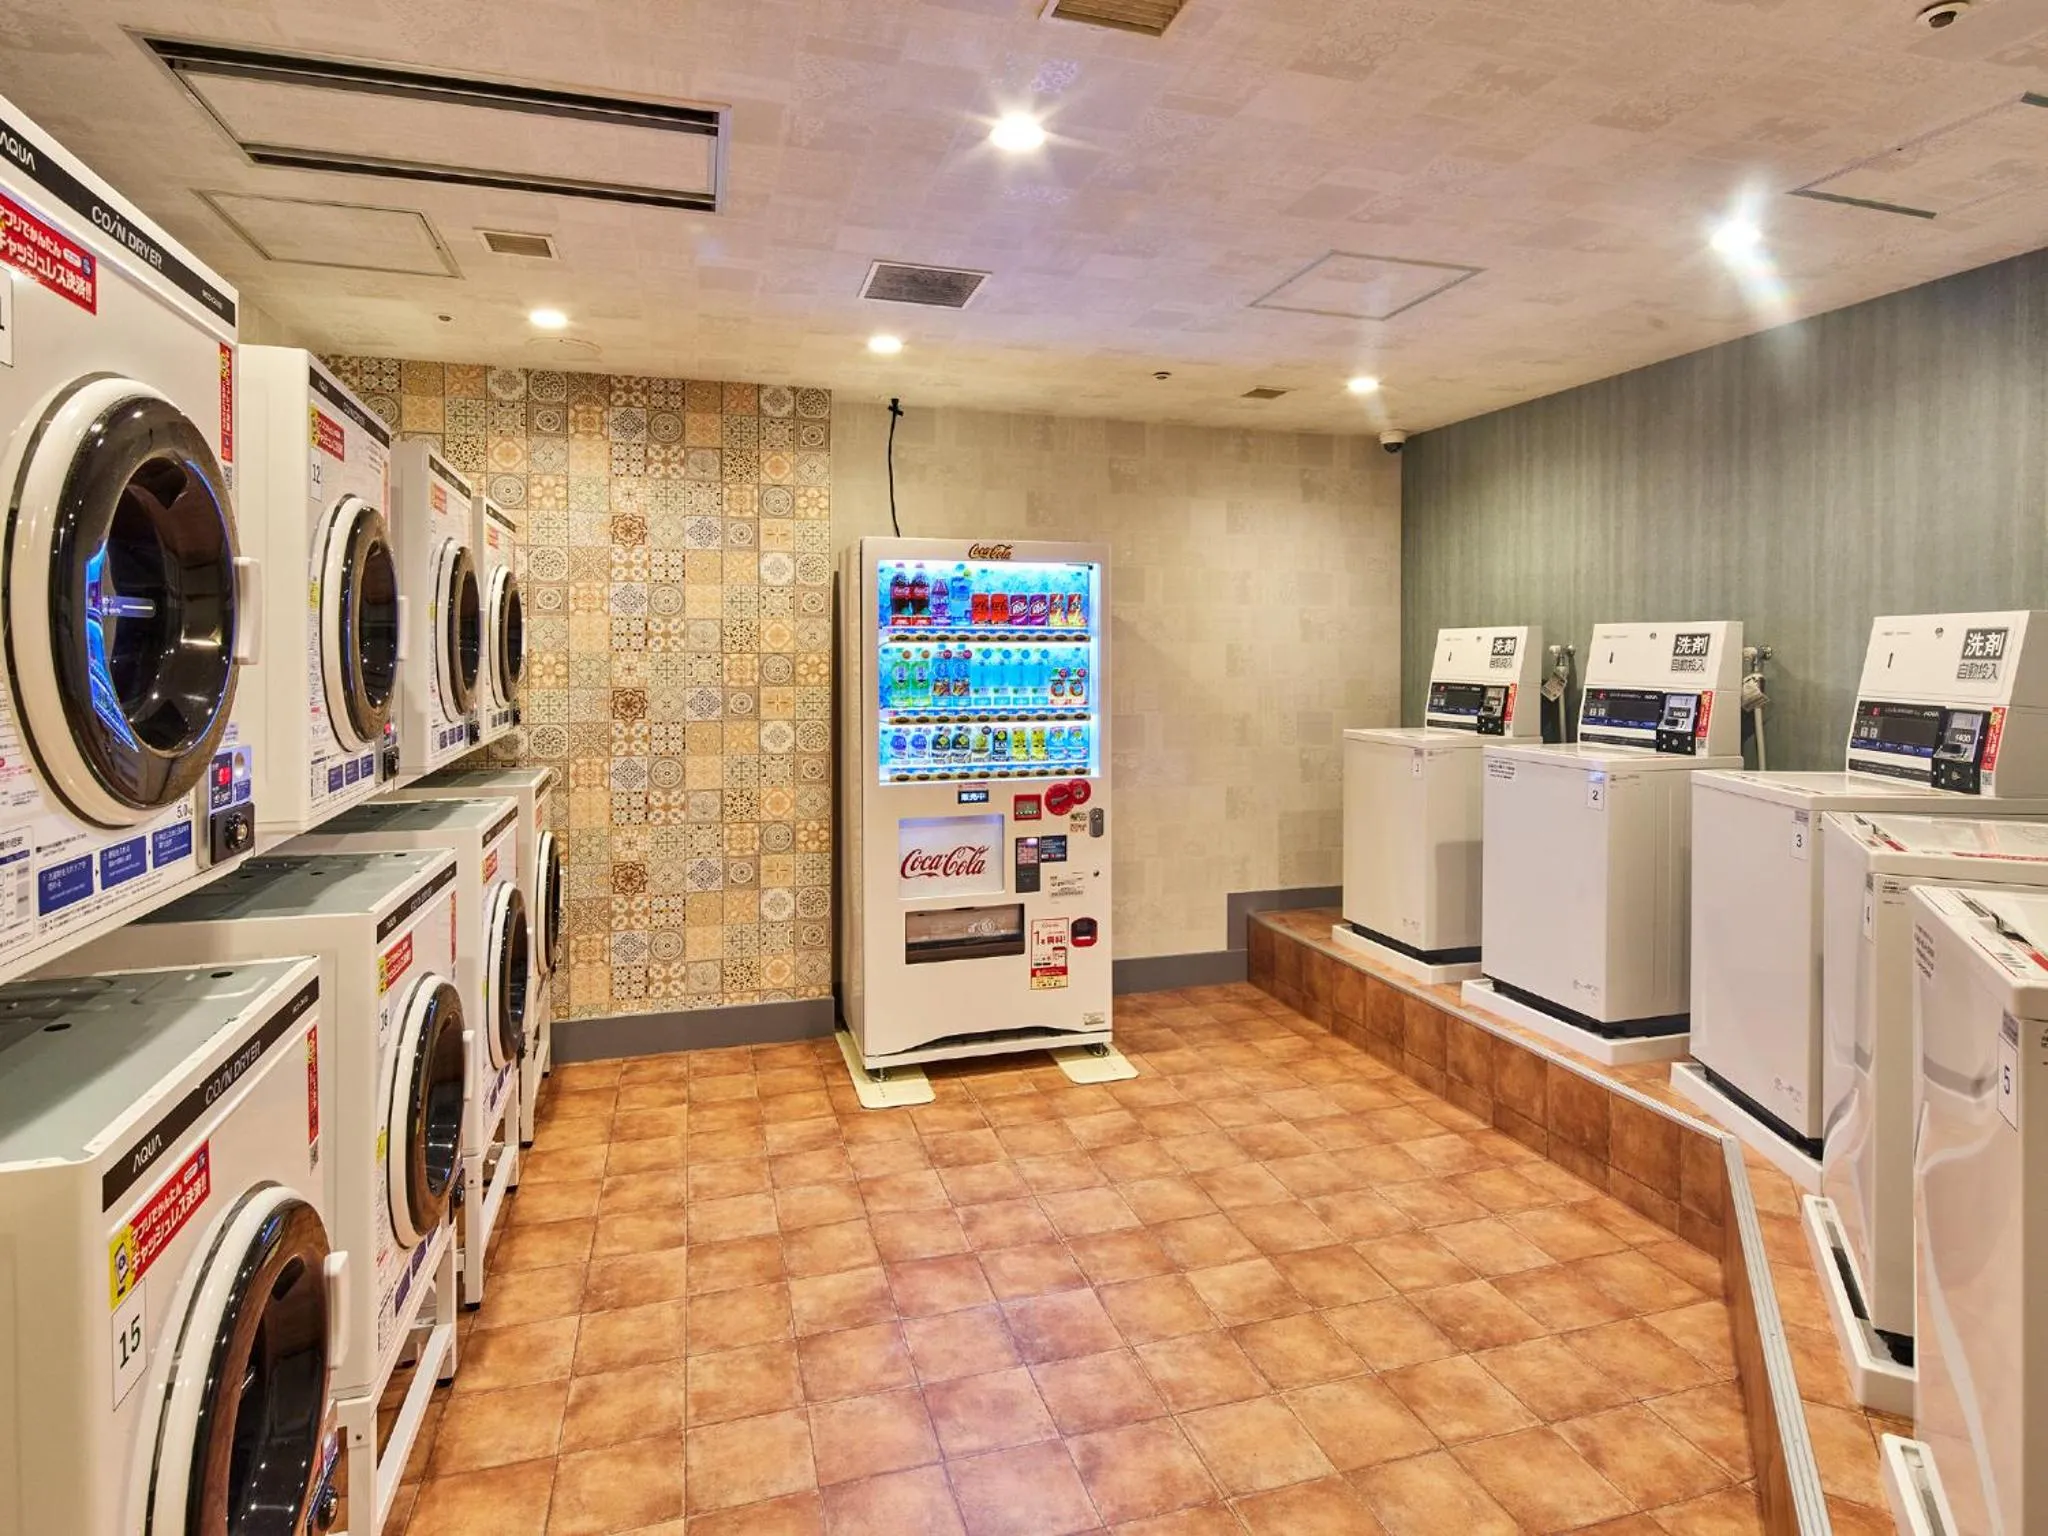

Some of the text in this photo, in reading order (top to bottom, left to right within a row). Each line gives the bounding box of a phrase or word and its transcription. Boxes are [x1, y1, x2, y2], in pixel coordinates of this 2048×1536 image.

[0, 131, 36, 172] AQUA
[127, 233, 162, 270] DRYER
[312, 463, 321, 485] 12
[1675, 636, 1709, 655] 洗剤
[1964, 631, 2005, 657] 洗剤
[1957, 662, 1998, 681] 自動投入
[1592, 790, 1599, 801] 2
[1796, 834, 1803, 848] 3
[233, 1040, 262, 1077] DRYER
[2003, 1065, 2011, 1096] 5
[133, 1134, 163, 1173] AQUA
[119, 1314, 142, 1369] 15
